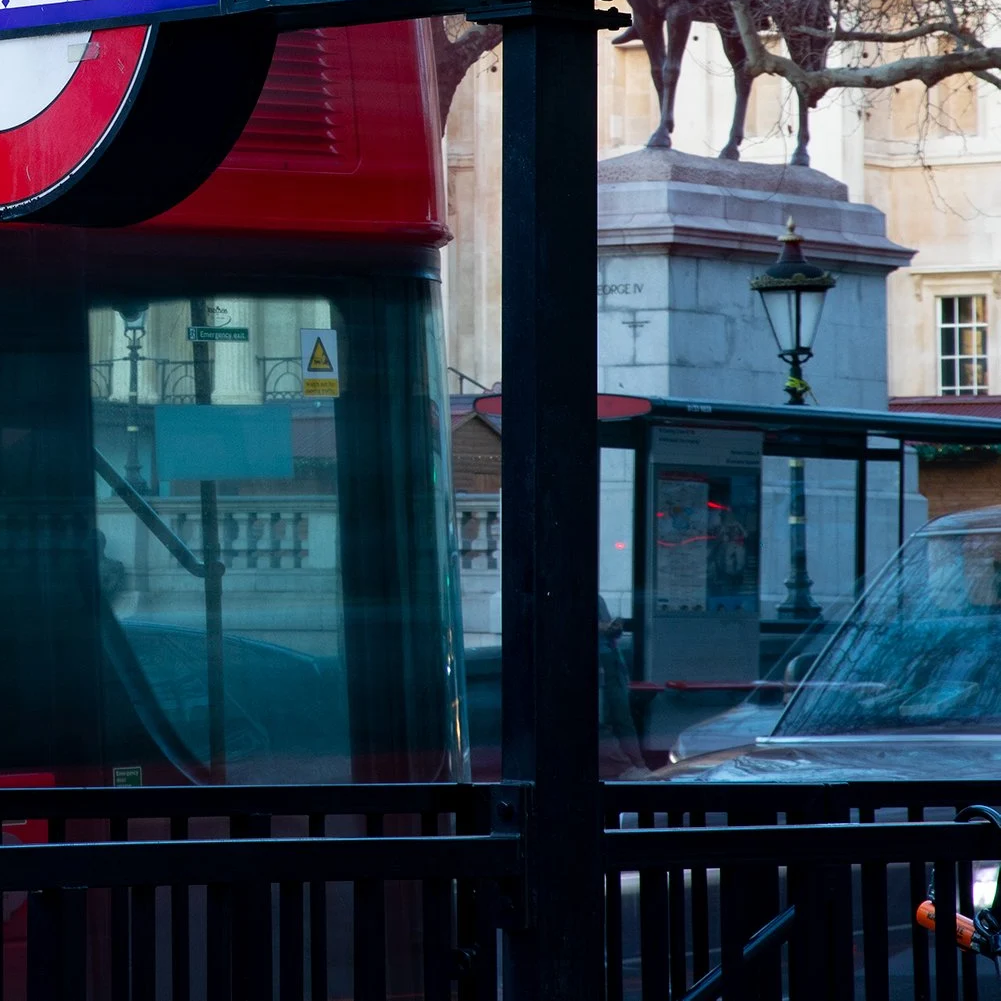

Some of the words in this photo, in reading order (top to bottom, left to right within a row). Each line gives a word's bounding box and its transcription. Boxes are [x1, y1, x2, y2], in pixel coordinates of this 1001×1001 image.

[597, 284, 631, 296] EORGE
[633, 283, 644, 294] IV
[200, 331, 231, 340] Emergency
